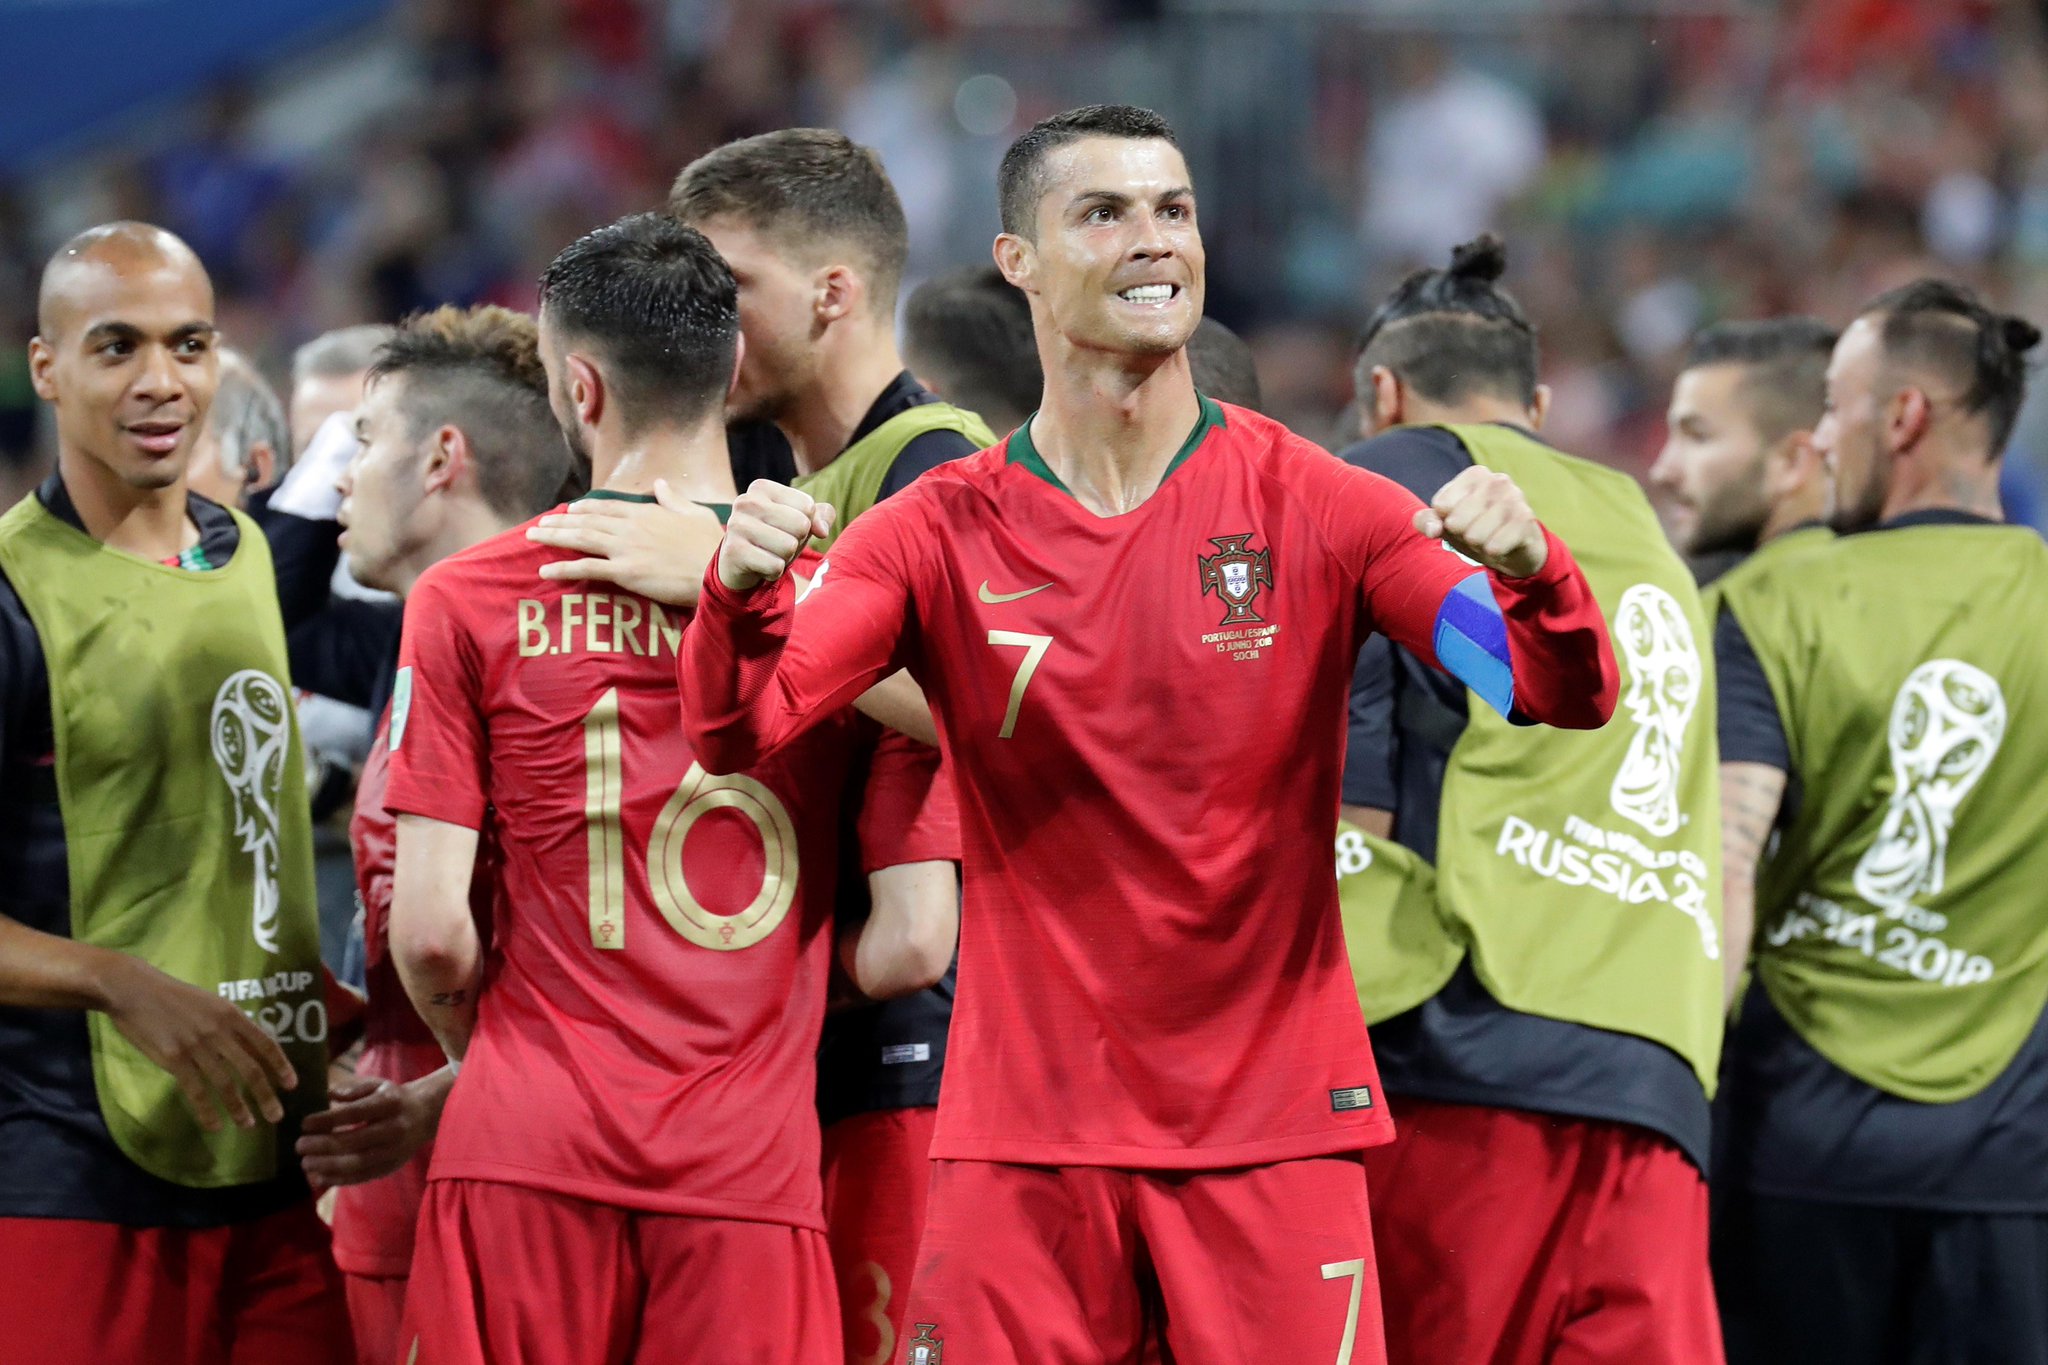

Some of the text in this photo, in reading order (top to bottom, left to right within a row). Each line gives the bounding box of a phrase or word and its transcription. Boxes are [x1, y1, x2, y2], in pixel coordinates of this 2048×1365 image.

[988, 630, 1054, 738] 7
[1216, 636, 1273, 653] 15 JUNHO 2018
[1233, 650, 1260, 661] SOCHI
[583, 686, 799, 951] 16
[1496, 815, 1669, 904] RUSSIA
[218, 978, 265, 1002] FIFA
[1321, 1258, 1365, 1365] 7
